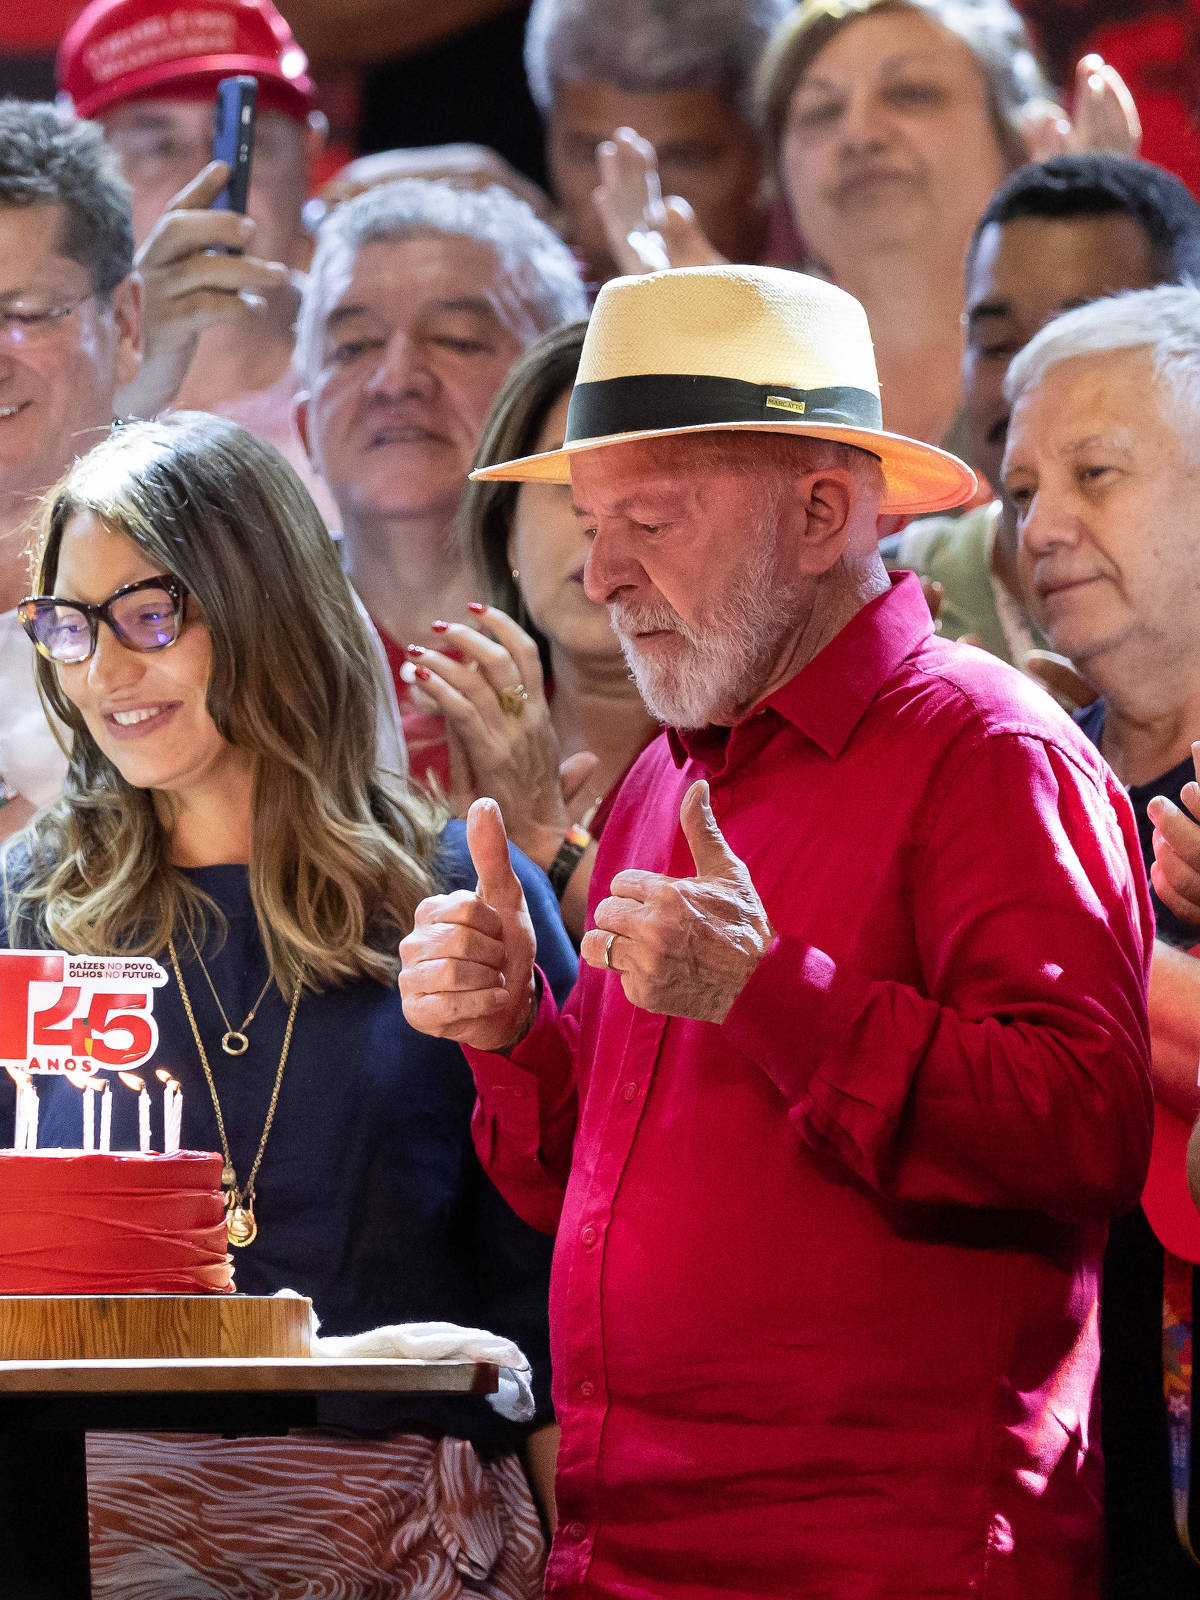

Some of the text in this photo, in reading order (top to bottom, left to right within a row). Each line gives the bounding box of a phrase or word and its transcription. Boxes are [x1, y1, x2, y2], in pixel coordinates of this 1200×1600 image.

[69, 960, 105, 970] RAÍZES
[107, 962, 123, 970] NO
[69, 970, 103, 978] OLHOS
[105, 971, 120, 979] NO
[33, 986, 152, 1065] 45
[29, 1057, 92, 1073] ANOS
